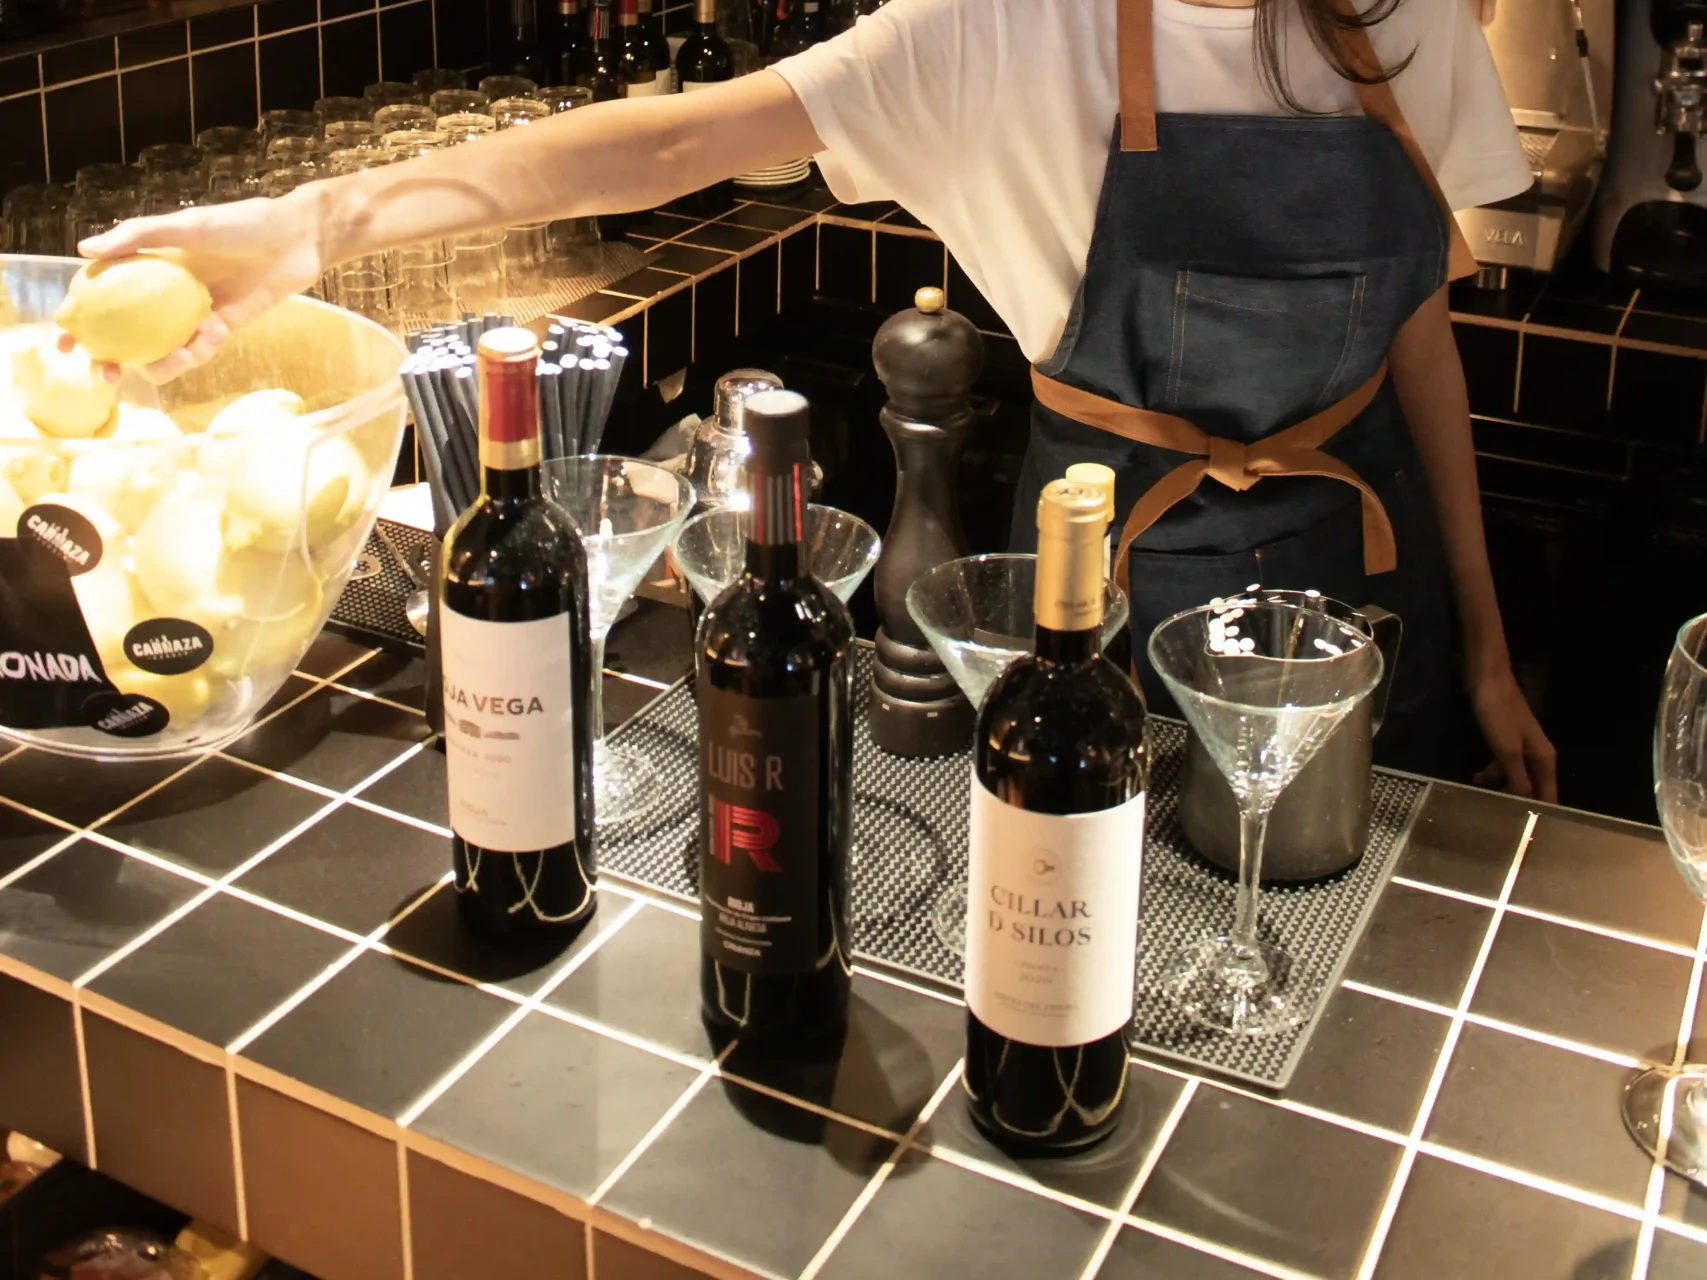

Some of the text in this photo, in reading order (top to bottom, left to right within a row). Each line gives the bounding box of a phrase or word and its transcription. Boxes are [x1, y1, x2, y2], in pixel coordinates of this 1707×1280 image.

[1485, 228, 1523, 246] VELA
[0, 651, 103, 683] ONADA
[472, 694, 544, 716] VEGA
[708, 741, 784, 791] LUIS R
[990, 885, 1093, 920] CILLAR
[1009, 924, 1092, 947] SILOS
